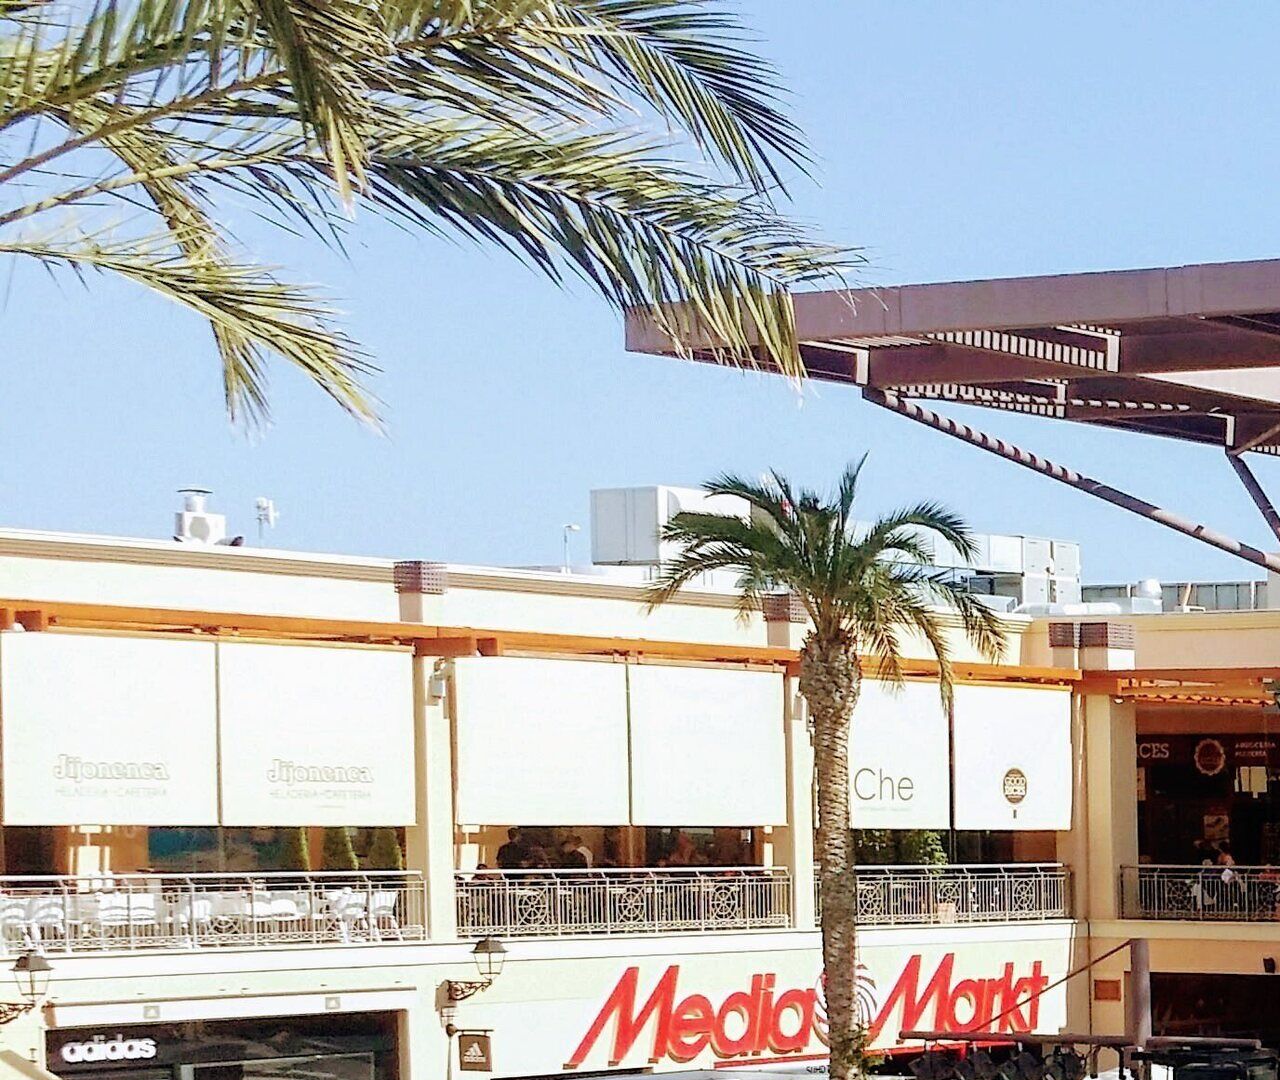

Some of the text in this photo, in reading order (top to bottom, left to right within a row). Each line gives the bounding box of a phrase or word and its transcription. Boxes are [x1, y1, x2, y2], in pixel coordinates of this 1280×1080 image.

[1138, 742, 1170, 759] CES
[854, 767, 914, 801] Che
[563, 952, 1049, 1069] Media Markt
[61, 1033, 157, 1063] adidas
